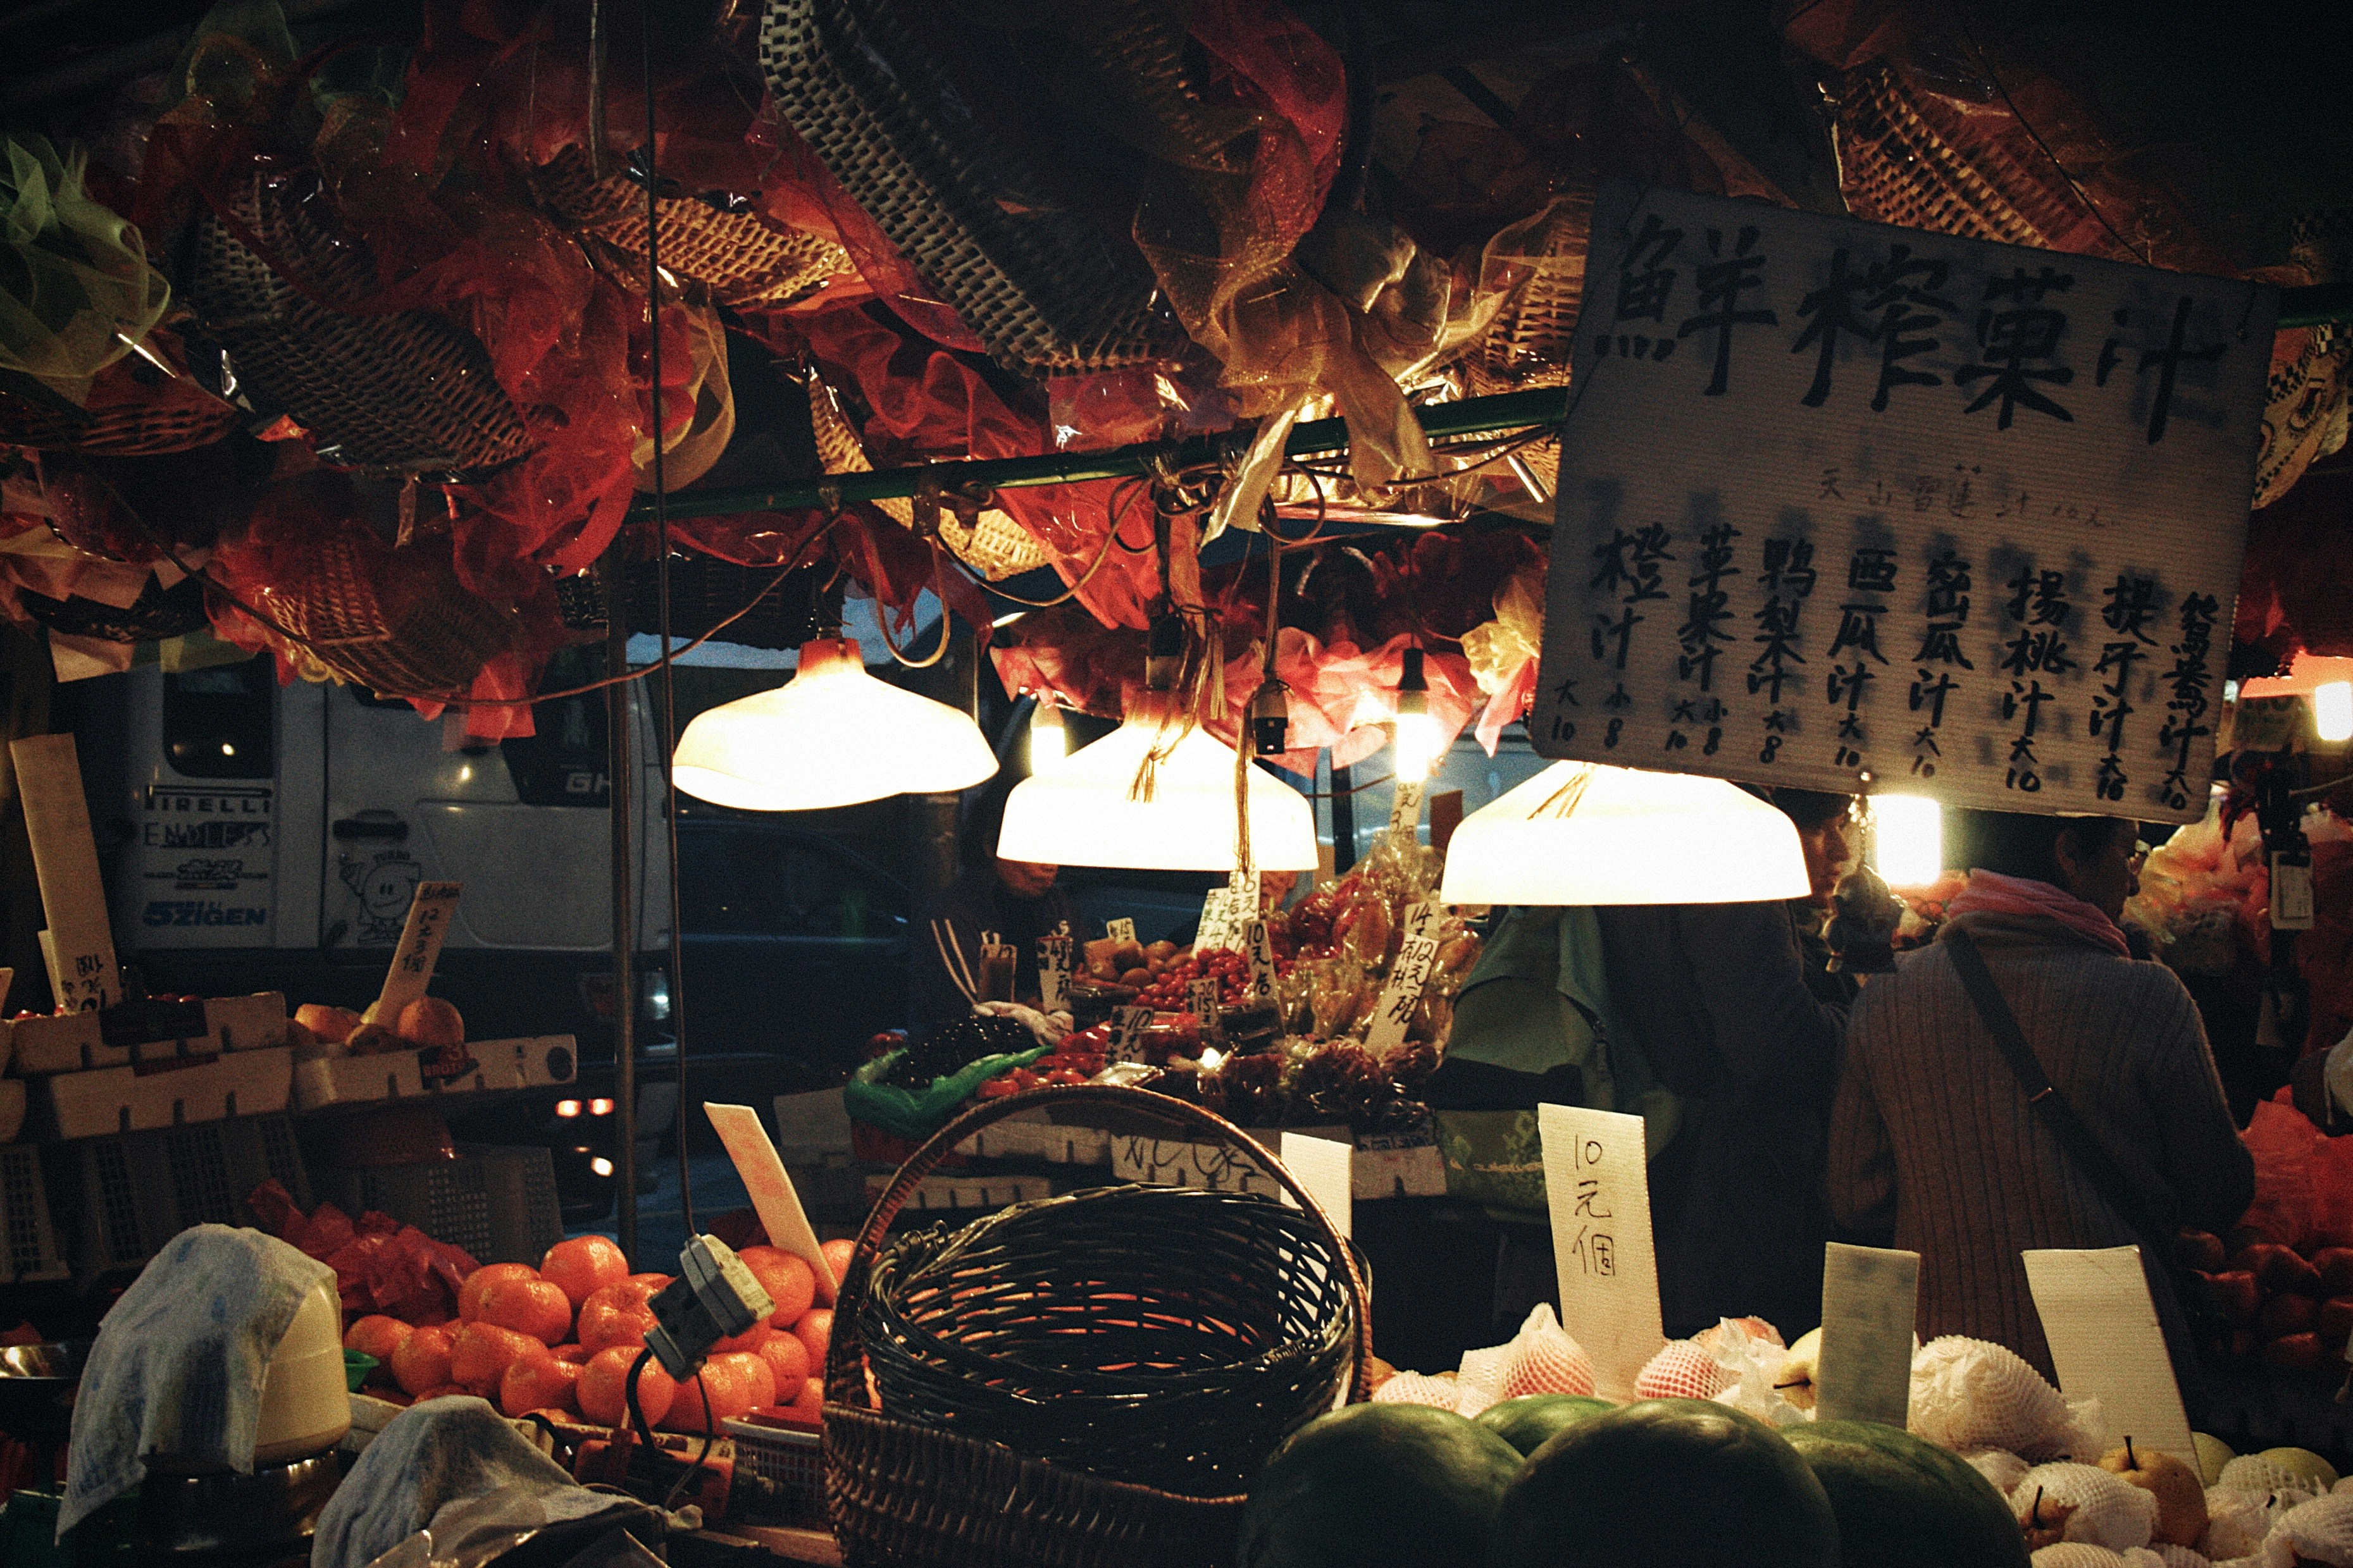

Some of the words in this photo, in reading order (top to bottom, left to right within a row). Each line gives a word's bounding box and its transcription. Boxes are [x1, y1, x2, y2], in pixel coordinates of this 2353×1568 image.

[1595, 213, 2227, 445] 鮮榨菓汁
[1589, 522, 1676, 670] 橙汁
[1827, 547, 1898, 711] 西瓜汁
[144, 789, 271, 813] PIRELLI
[144, 822, 271, 848] ENDLESS
[1572, 1133, 1615, 1276] 10元個
